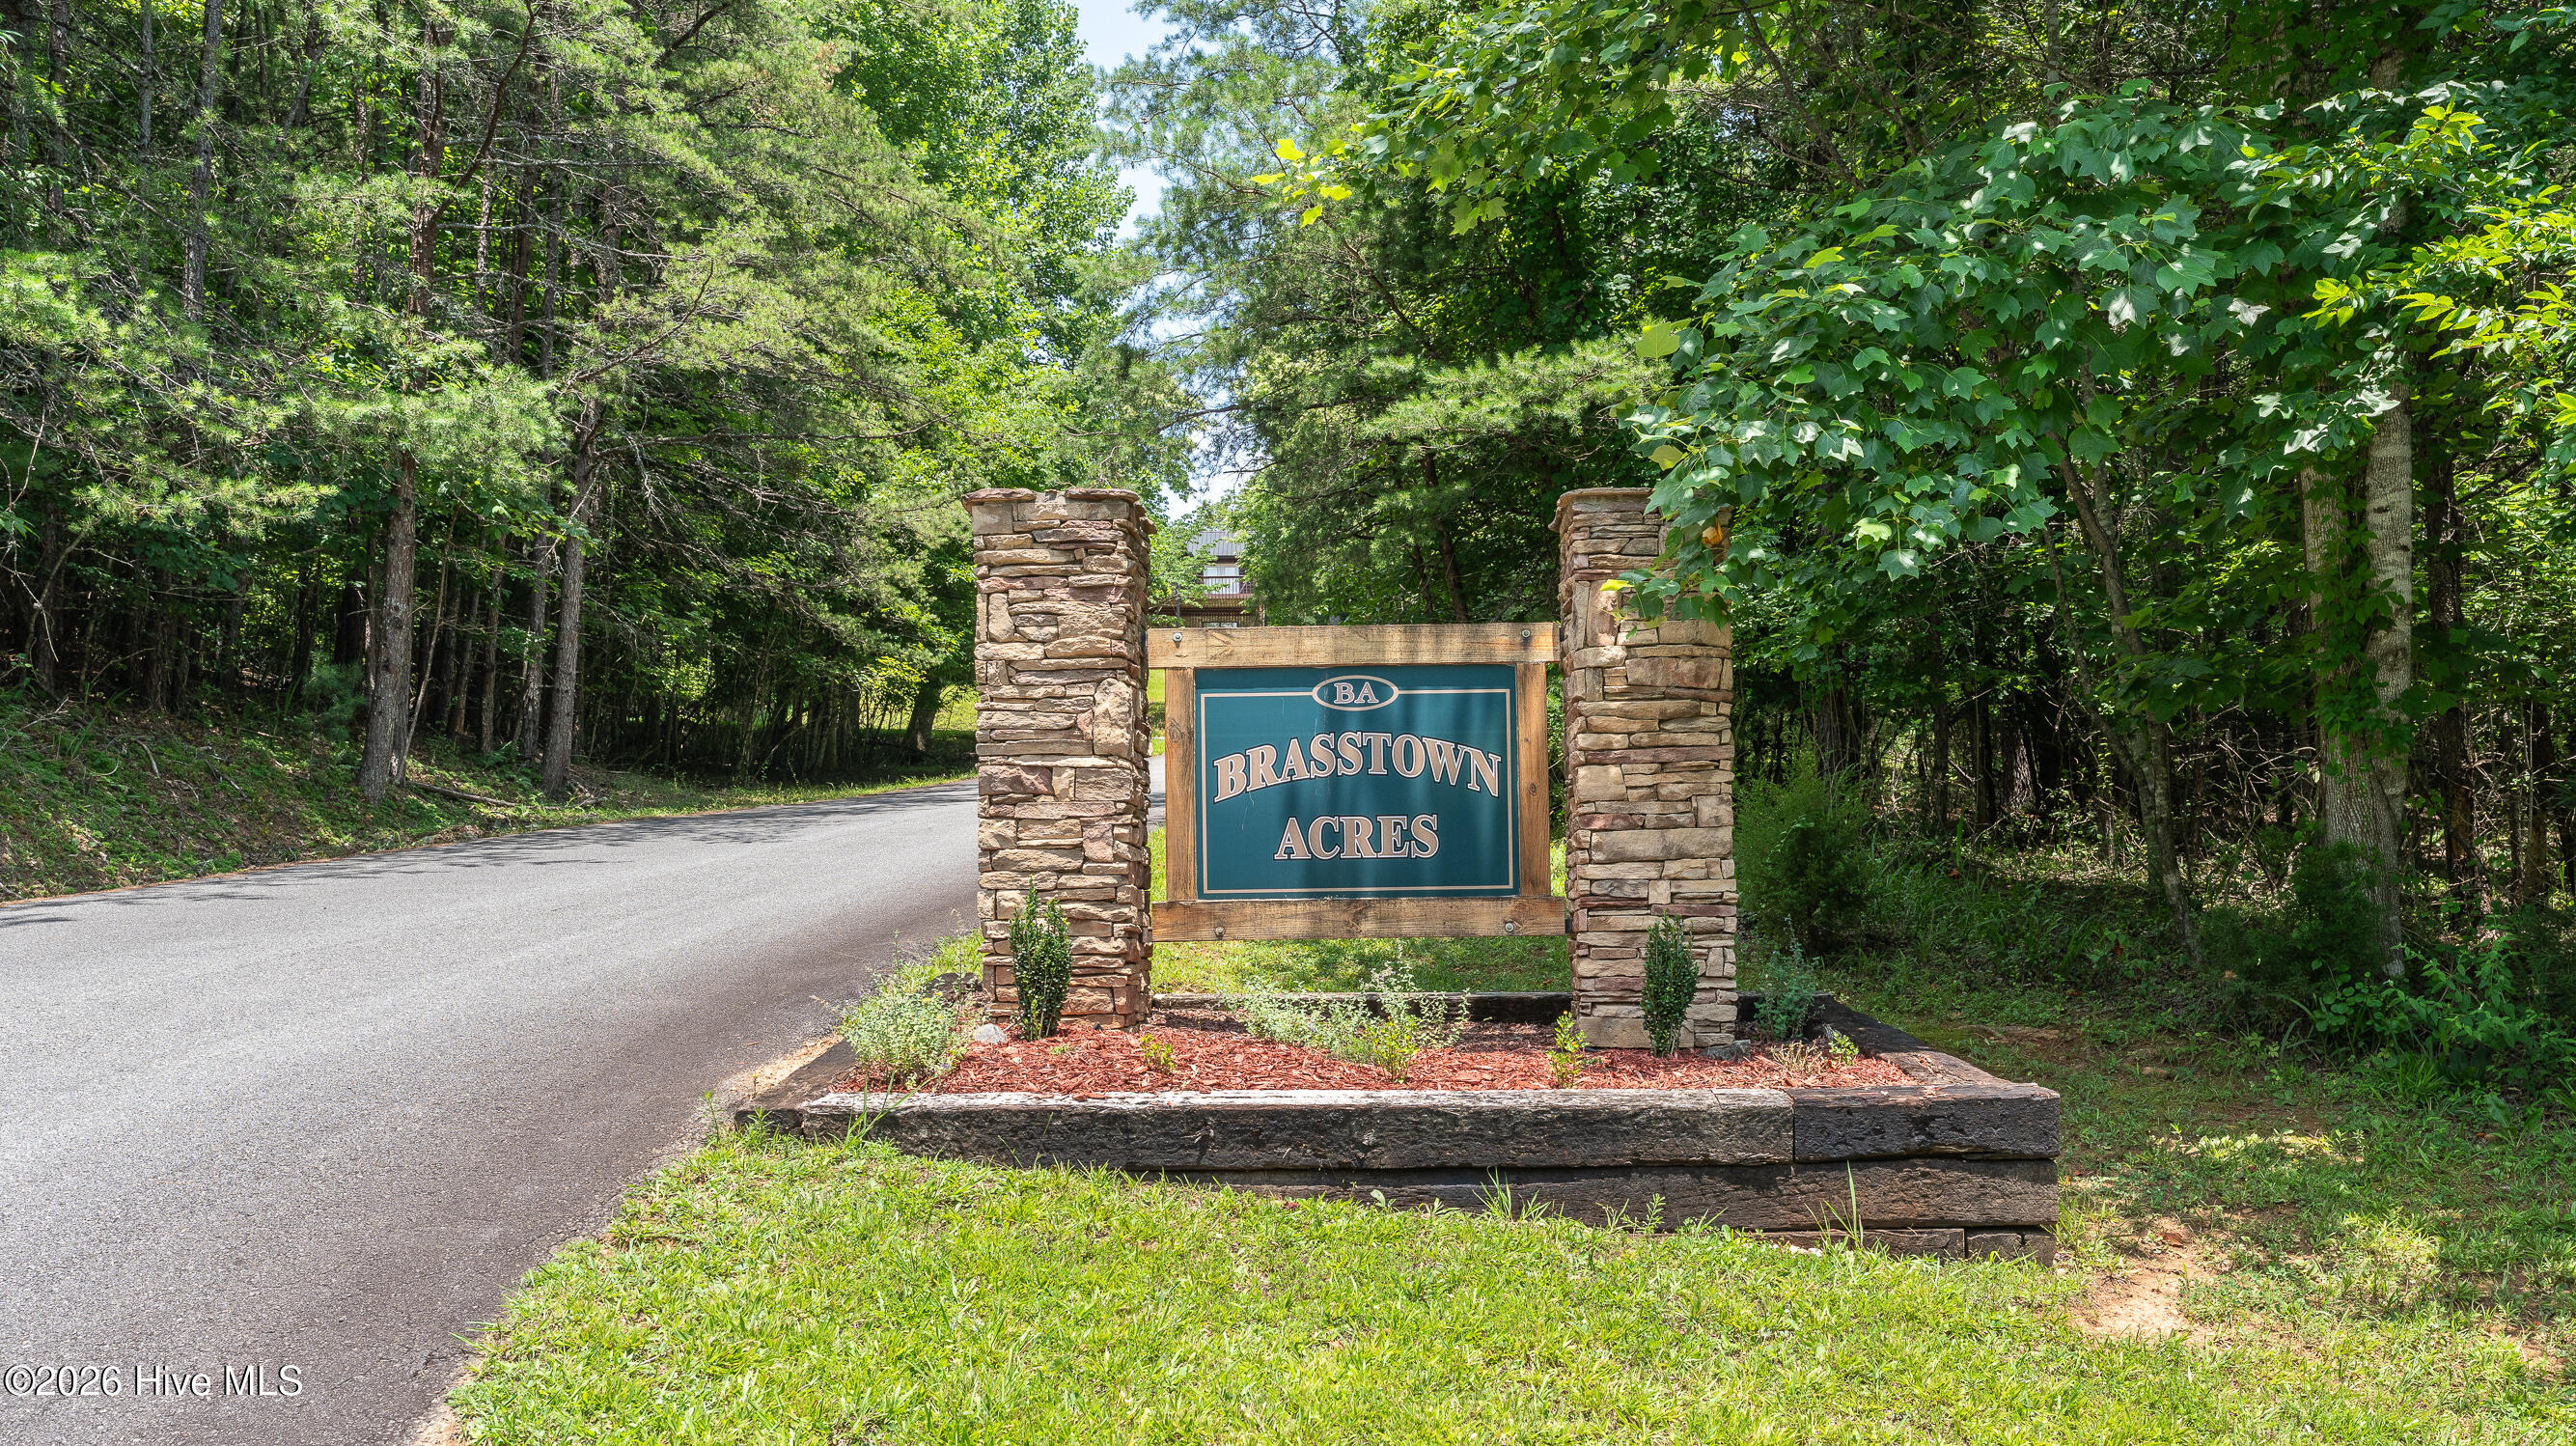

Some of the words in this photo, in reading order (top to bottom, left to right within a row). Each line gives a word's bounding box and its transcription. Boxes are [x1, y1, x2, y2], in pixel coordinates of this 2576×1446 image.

[1333, 681, 1379, 705] BA
[1213, 731, 1502, 803] BRASSTOWN
[1273, 813, 1440, 860] ACRES
